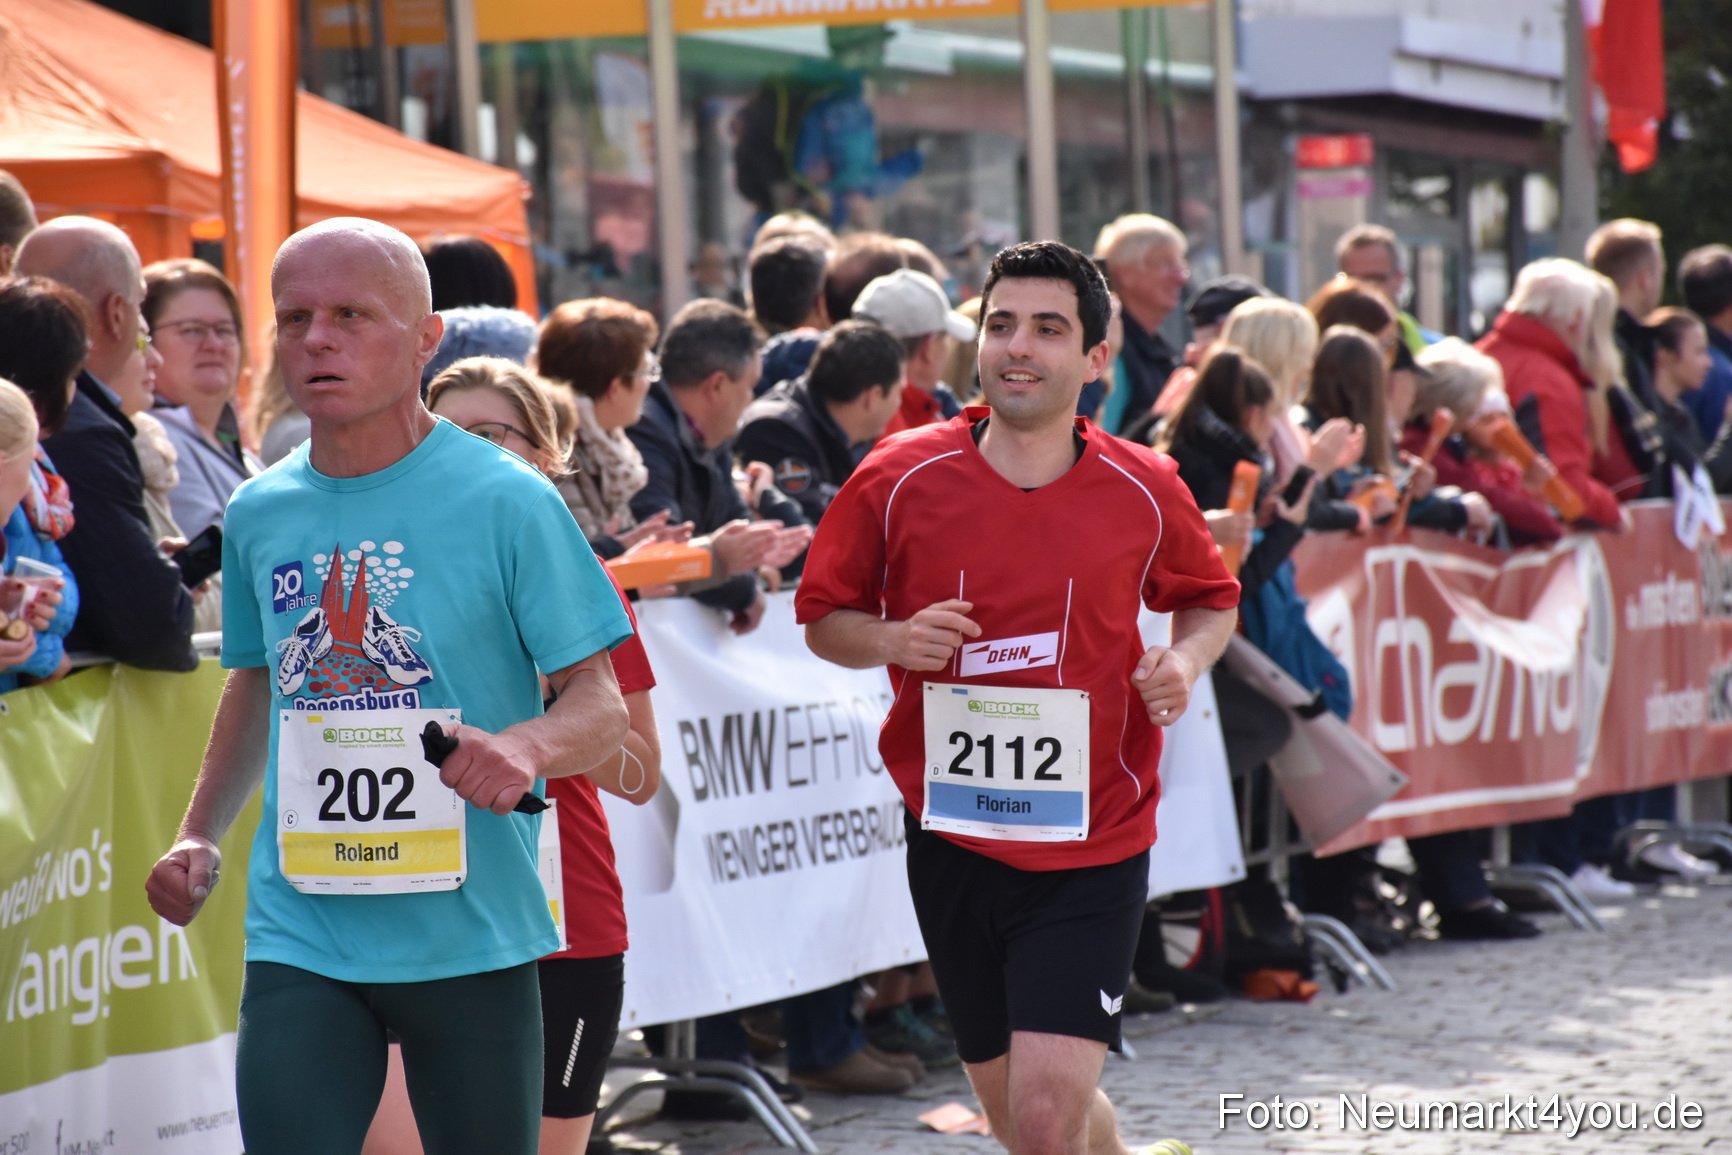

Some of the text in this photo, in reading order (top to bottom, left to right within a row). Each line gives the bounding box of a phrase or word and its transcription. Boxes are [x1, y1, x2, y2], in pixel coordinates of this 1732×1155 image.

[273, 569, 302, 602] 20
[285, 594, 317, 615] jahre
[986, 645, 1031, 664] DEHN
[983, 701, 1040, 716] BOCK
[338, 727, 404, 743] BOCK
[678, 709, 776, 802] BMW
[948, 731, 1062, 781] 2112
[933, 766, 939, 776] D
[317, 767, 416, 822] 202
[977, 795, 1031, 814] Florian
[287, 814, 294, 825] C
[335, 842, 399, 861] Roland
[705, 820, 801, 882] WENIGER
